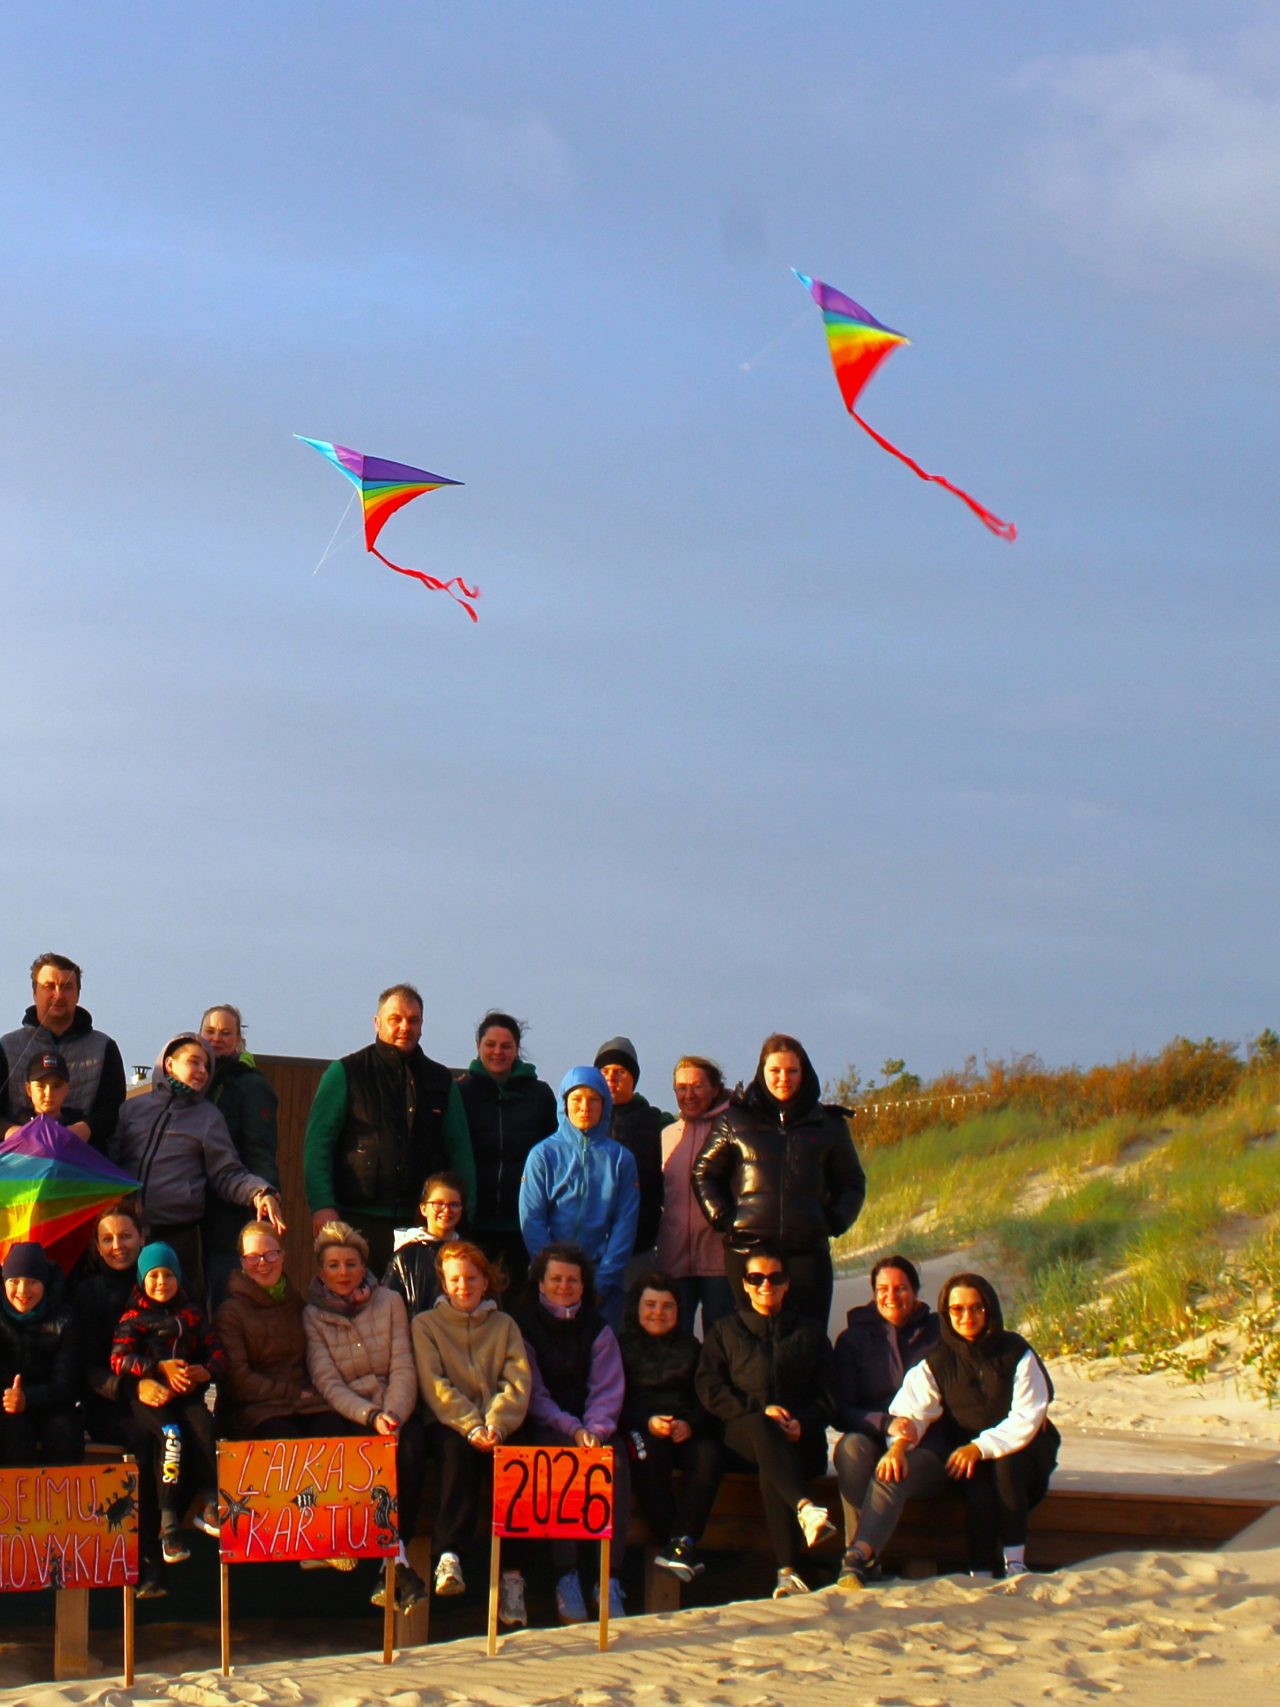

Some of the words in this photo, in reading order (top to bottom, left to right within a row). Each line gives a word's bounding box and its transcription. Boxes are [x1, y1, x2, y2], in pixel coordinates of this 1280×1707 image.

[162, 1438, 181, 1484] SONIC
[237, 1441, 374, 1495] LAIKAS
[502, 1449, 612, 1535] 2026
[246, 1505, 370, 1557] KARTU
